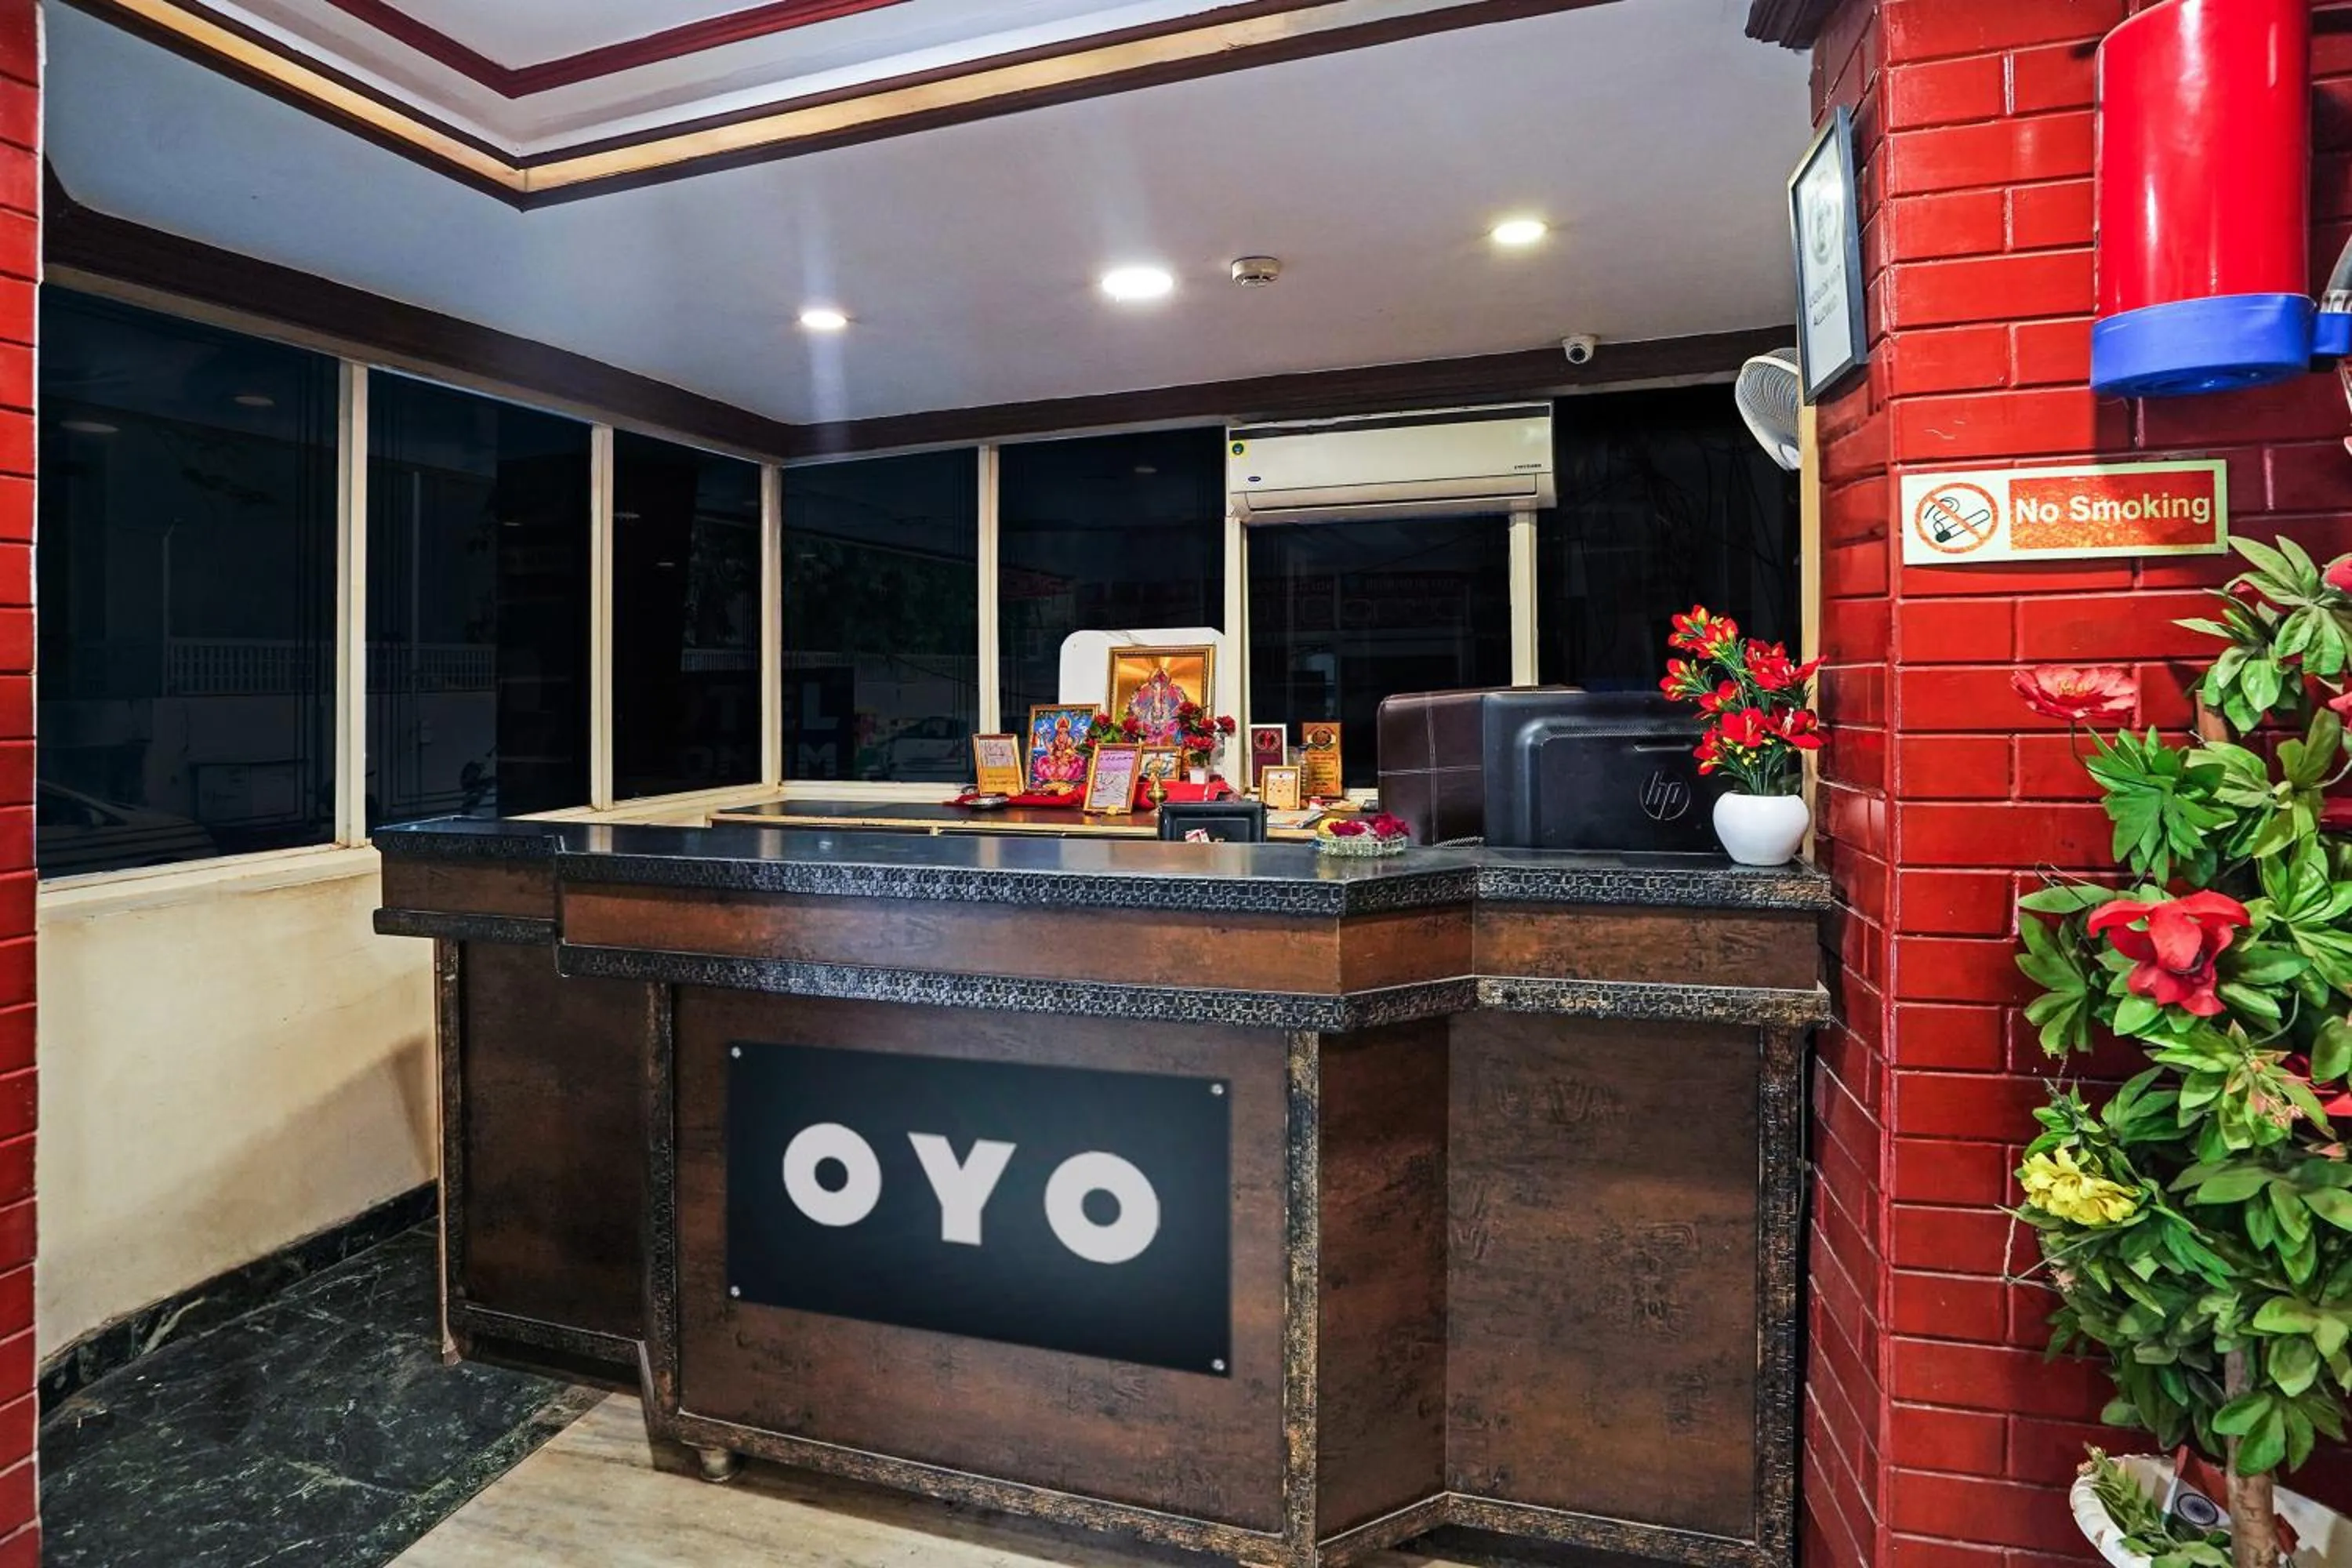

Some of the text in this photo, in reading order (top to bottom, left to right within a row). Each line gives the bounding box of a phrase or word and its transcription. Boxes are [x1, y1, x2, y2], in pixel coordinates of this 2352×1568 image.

[2016, 492, 2210, 524] No Smoking
[782, 1121, 1161, 1265] OYO
